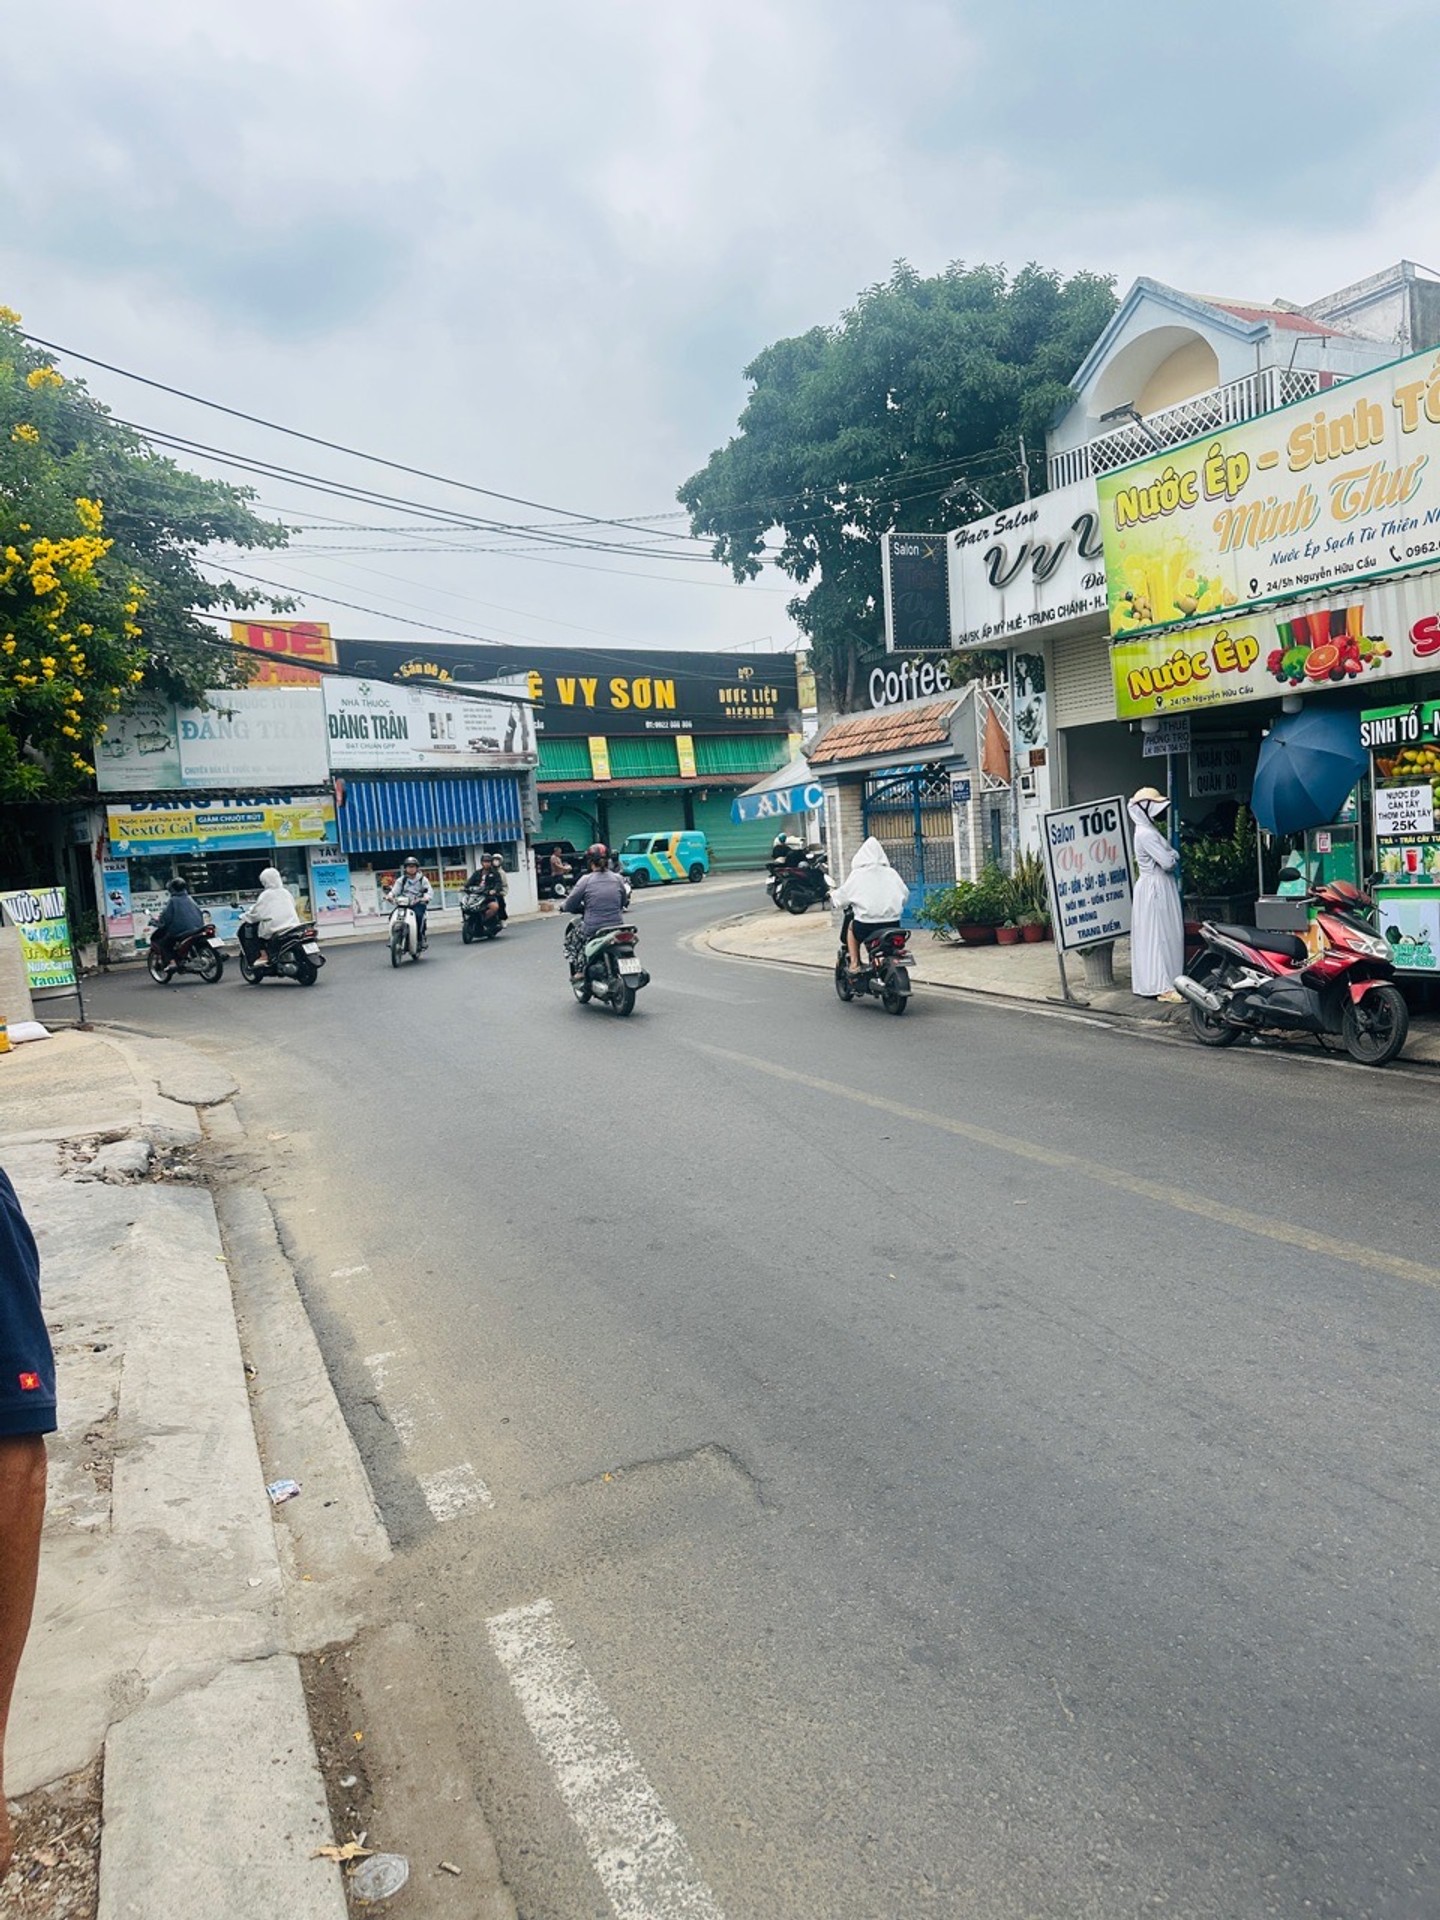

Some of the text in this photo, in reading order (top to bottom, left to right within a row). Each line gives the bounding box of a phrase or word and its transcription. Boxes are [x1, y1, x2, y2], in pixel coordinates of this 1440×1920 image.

[1115, 467, 1198, 530] Nước
[1204, 442, 1249, 501] Ép
[1288, 398, 1384, 472] Sinh
[1213, 454, 1429, 553] Minh Thư
[954, 509, 1039, 549] Hair Salon
[1269, 550, 1300, 567] Nước
[1304, 538, 1320, 559] Ép
[1324, 531, 1354, 554] Sạch
[1360, 526, 1377, 543] Từ
[1381, 517, 1418, 538] Thiên
[893, 541, 919, 556] Salon
[1082, 571, 1107, 590] Đà
[1334, 562, 1354, 577] Hữu
[1028, 608, 1056, 627] TRUNG
[1057, 599, 1088, 617] CHÁNH
[1094, 596, 1108, 608] H.
[248, 622, 324, 655] DÊ
[1127, 630, 1259, 700] Nước Ép
[528, 671, 676, 709] Ê VY SƠN
[869, 658, 951, 708] Coffee
[341, 698, 359, 707] NHÀ
[180, 714, 251, 741] ĐĂNG
[328, 709, 409, 739] ĐĂNG TRÂN
[1360, 716, 1396, 747] SINH
[1400, 704, 1418, 740] TỐ
[119, 822, 193, 836] NextG Cal
[1051, 823, 1075, 845] Salon
[1079, 807, 1117, 837] TÓC
[1392, 819, 1418, 831] 25K
[318, 845, 337, 857] TÂY
